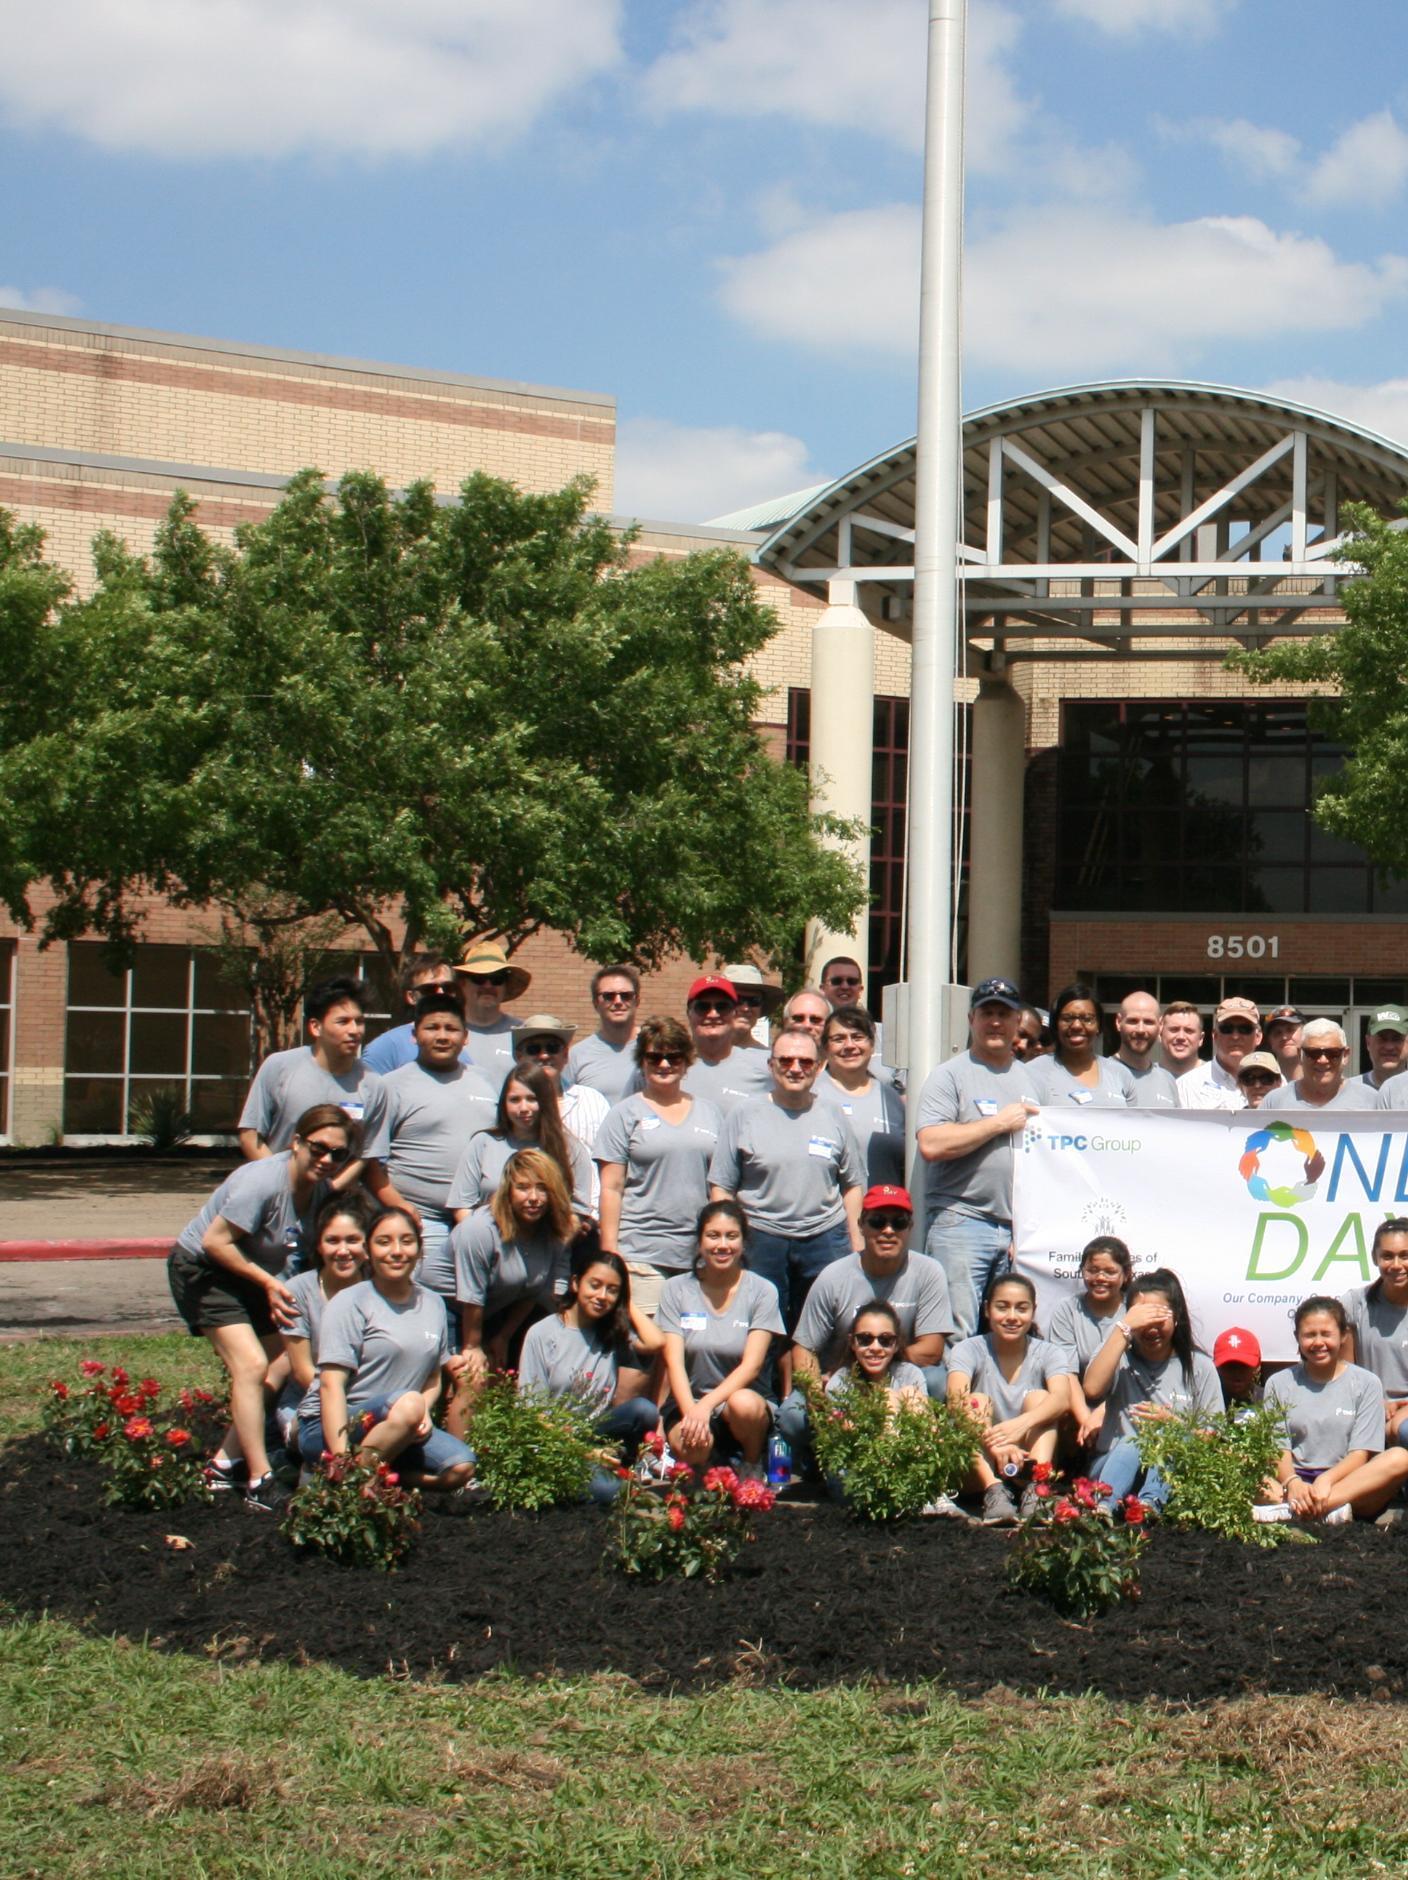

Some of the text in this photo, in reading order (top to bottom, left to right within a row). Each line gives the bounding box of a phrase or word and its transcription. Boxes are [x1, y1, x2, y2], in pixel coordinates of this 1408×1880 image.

[1206, 935, 1279, 958] 8501
[1047, 1135, 1142, 1155] TPC Group
[1048, 1251, 1082, 1262] Famil
[1145, 1252, 1158, 1263] of
[1223, 1292, 1245, 1304] Our
